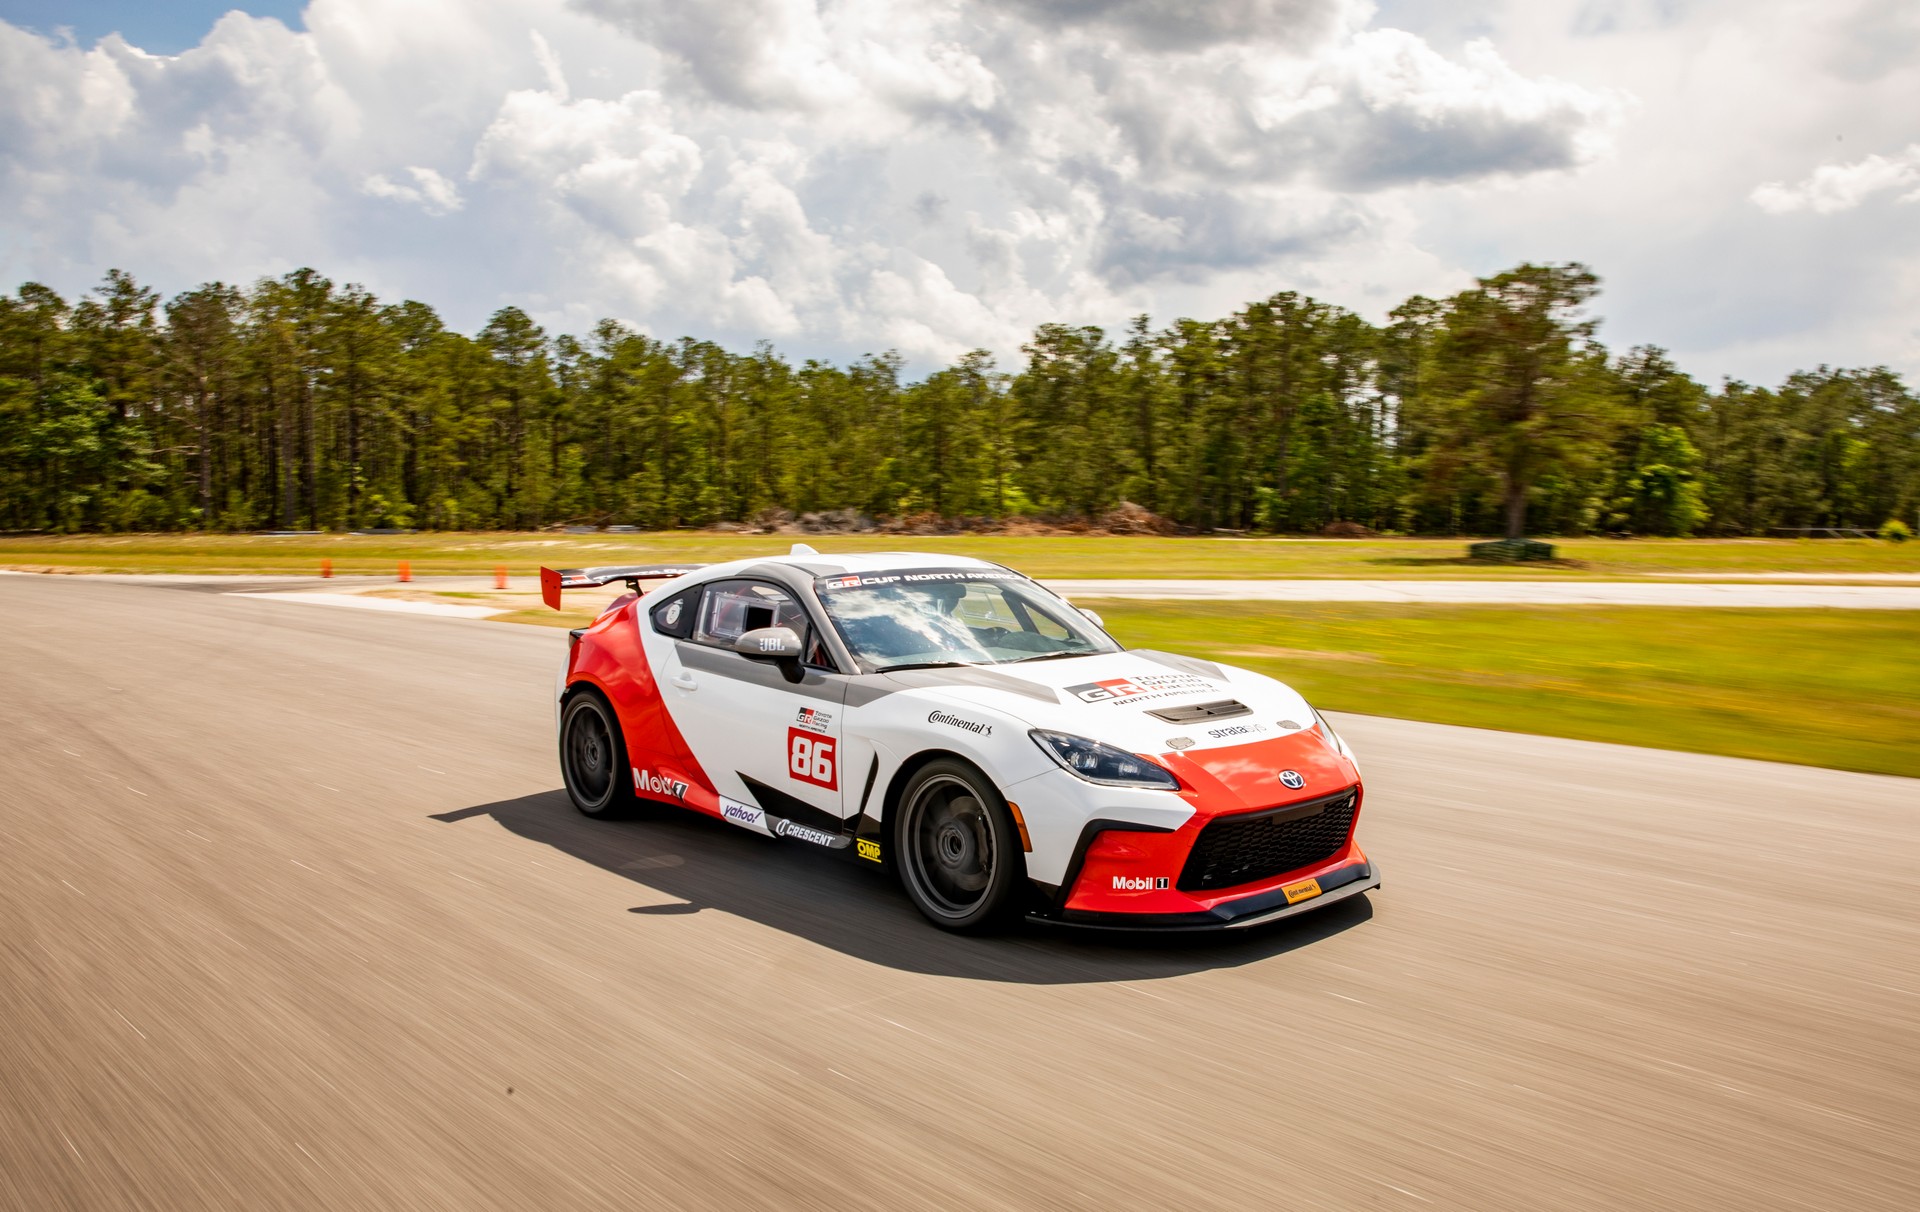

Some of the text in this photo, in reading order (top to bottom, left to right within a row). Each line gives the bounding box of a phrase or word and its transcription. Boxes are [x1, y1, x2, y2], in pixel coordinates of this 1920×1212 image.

[827, 573, 1022, 589] GR CUP NORTH AMERIC
[760, 638, 785, 651] JBL
[1074, 682, 1147, 702] GR
[1113, 693, 1163, 706] NORTH
[797, 711, 812, 724] GR
[928, 710, 985, 734] Continental
[791, 736, 833, 783] 86
[724, 804, 761, 824] yahoo!
[786, 824, 833, 847] CRESCENT
[857, 842, 881, 859] OMP
[1112, 876, 1153, 890] Mobil
